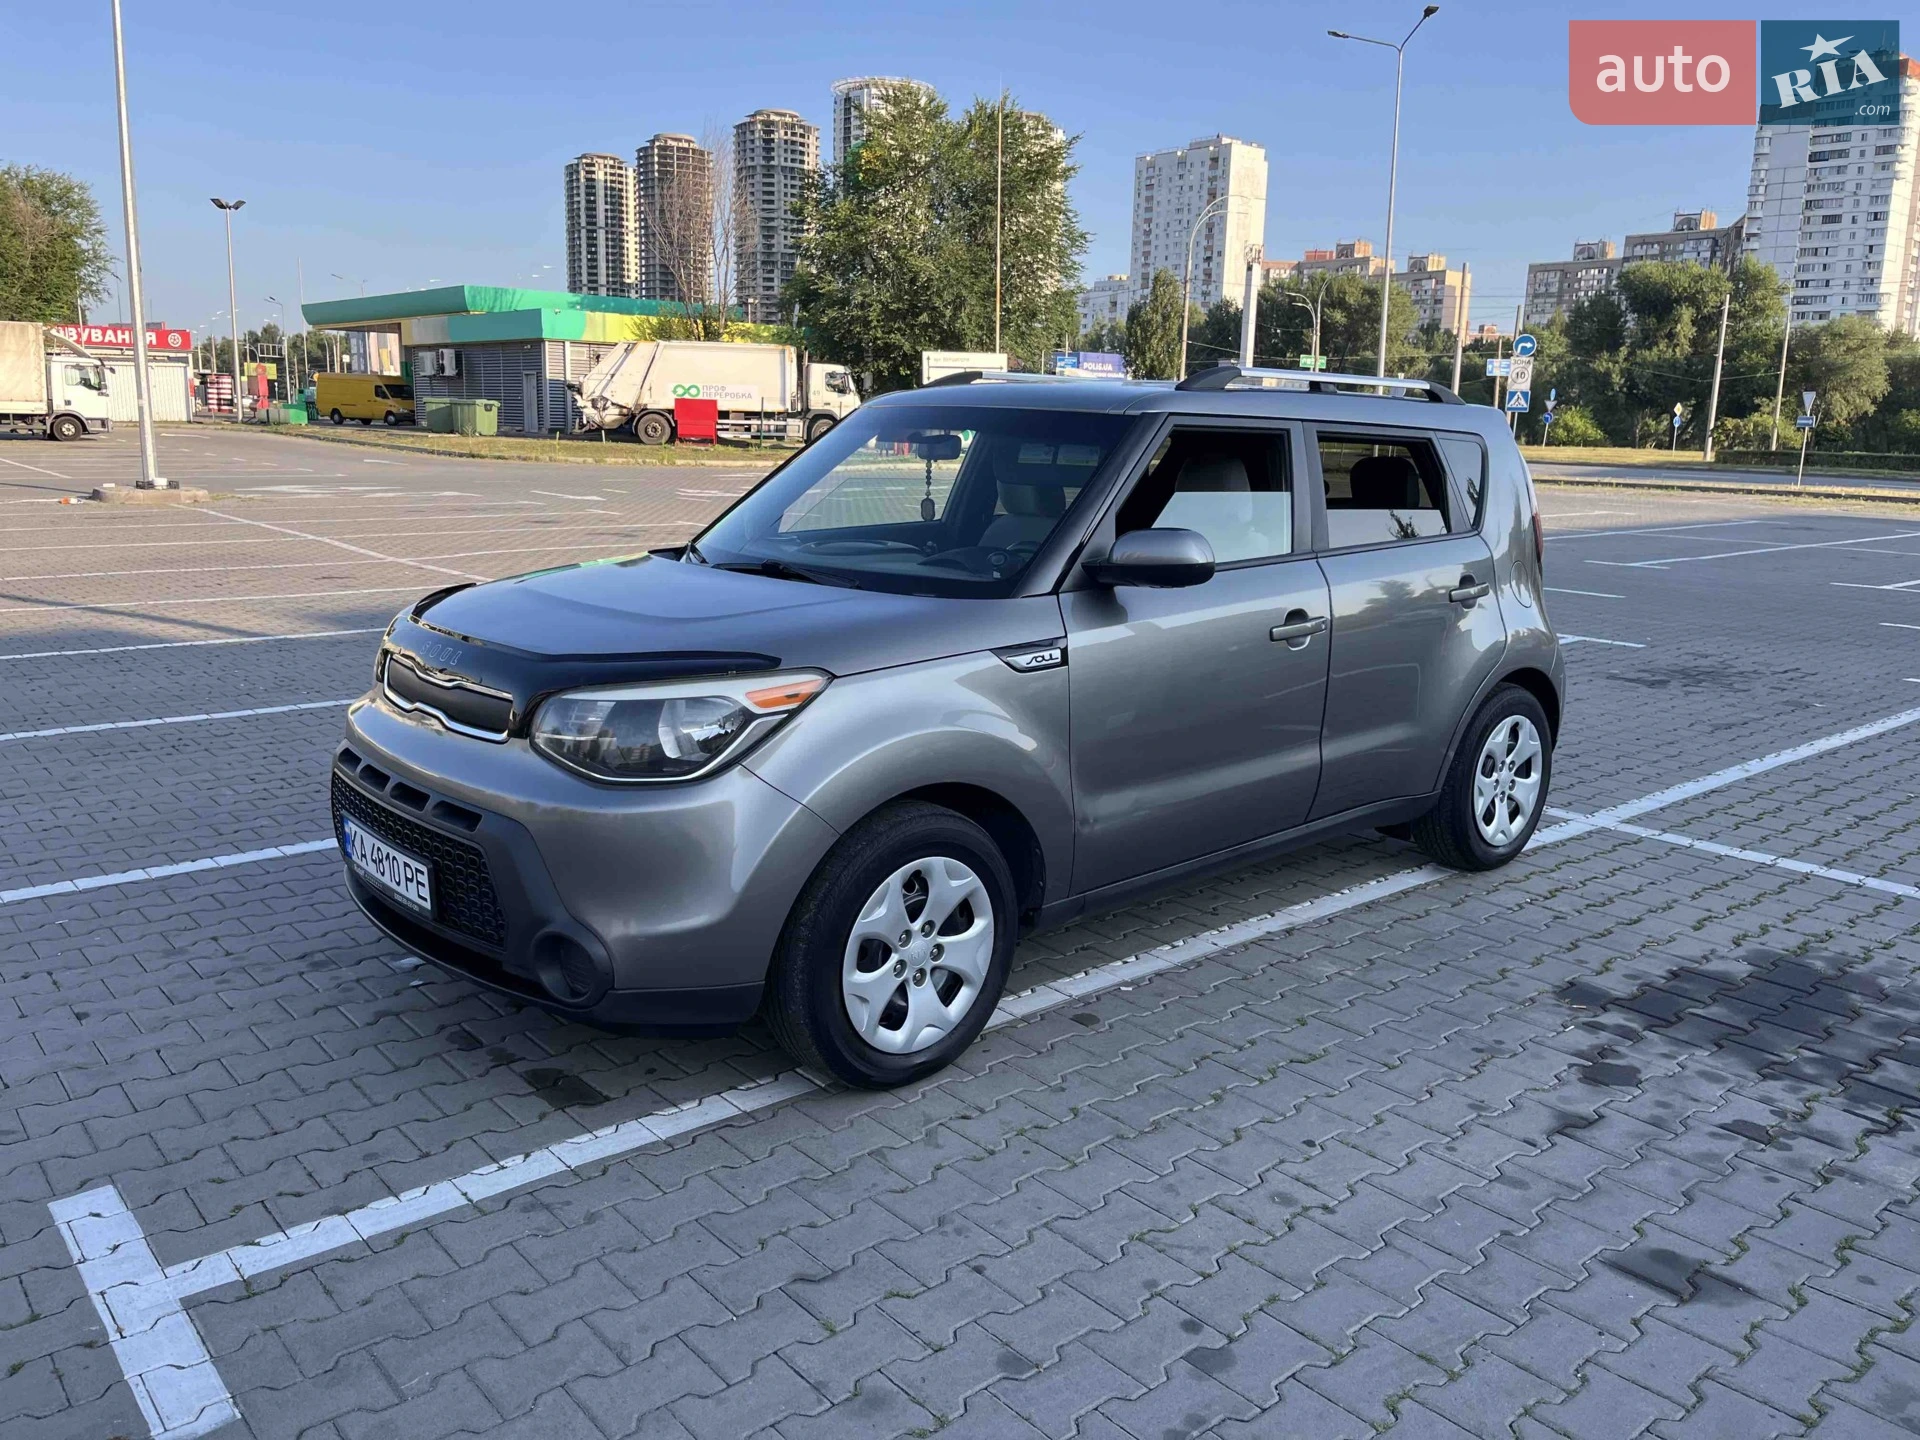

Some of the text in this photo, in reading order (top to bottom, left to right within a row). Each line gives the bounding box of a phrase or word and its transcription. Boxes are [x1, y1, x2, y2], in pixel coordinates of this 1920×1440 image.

[1515, 371, 1526, 379] 10
[702, 384, 727, 392] ПРОФ
[702, 391, 753, 400] ПЕРЕРОБКА
[420, 640, 463, 666] SOUL
[350, 827, 369, 867] KA
[370, 842, 401, 887] 4810
[403, 860, 428, 903] PE
